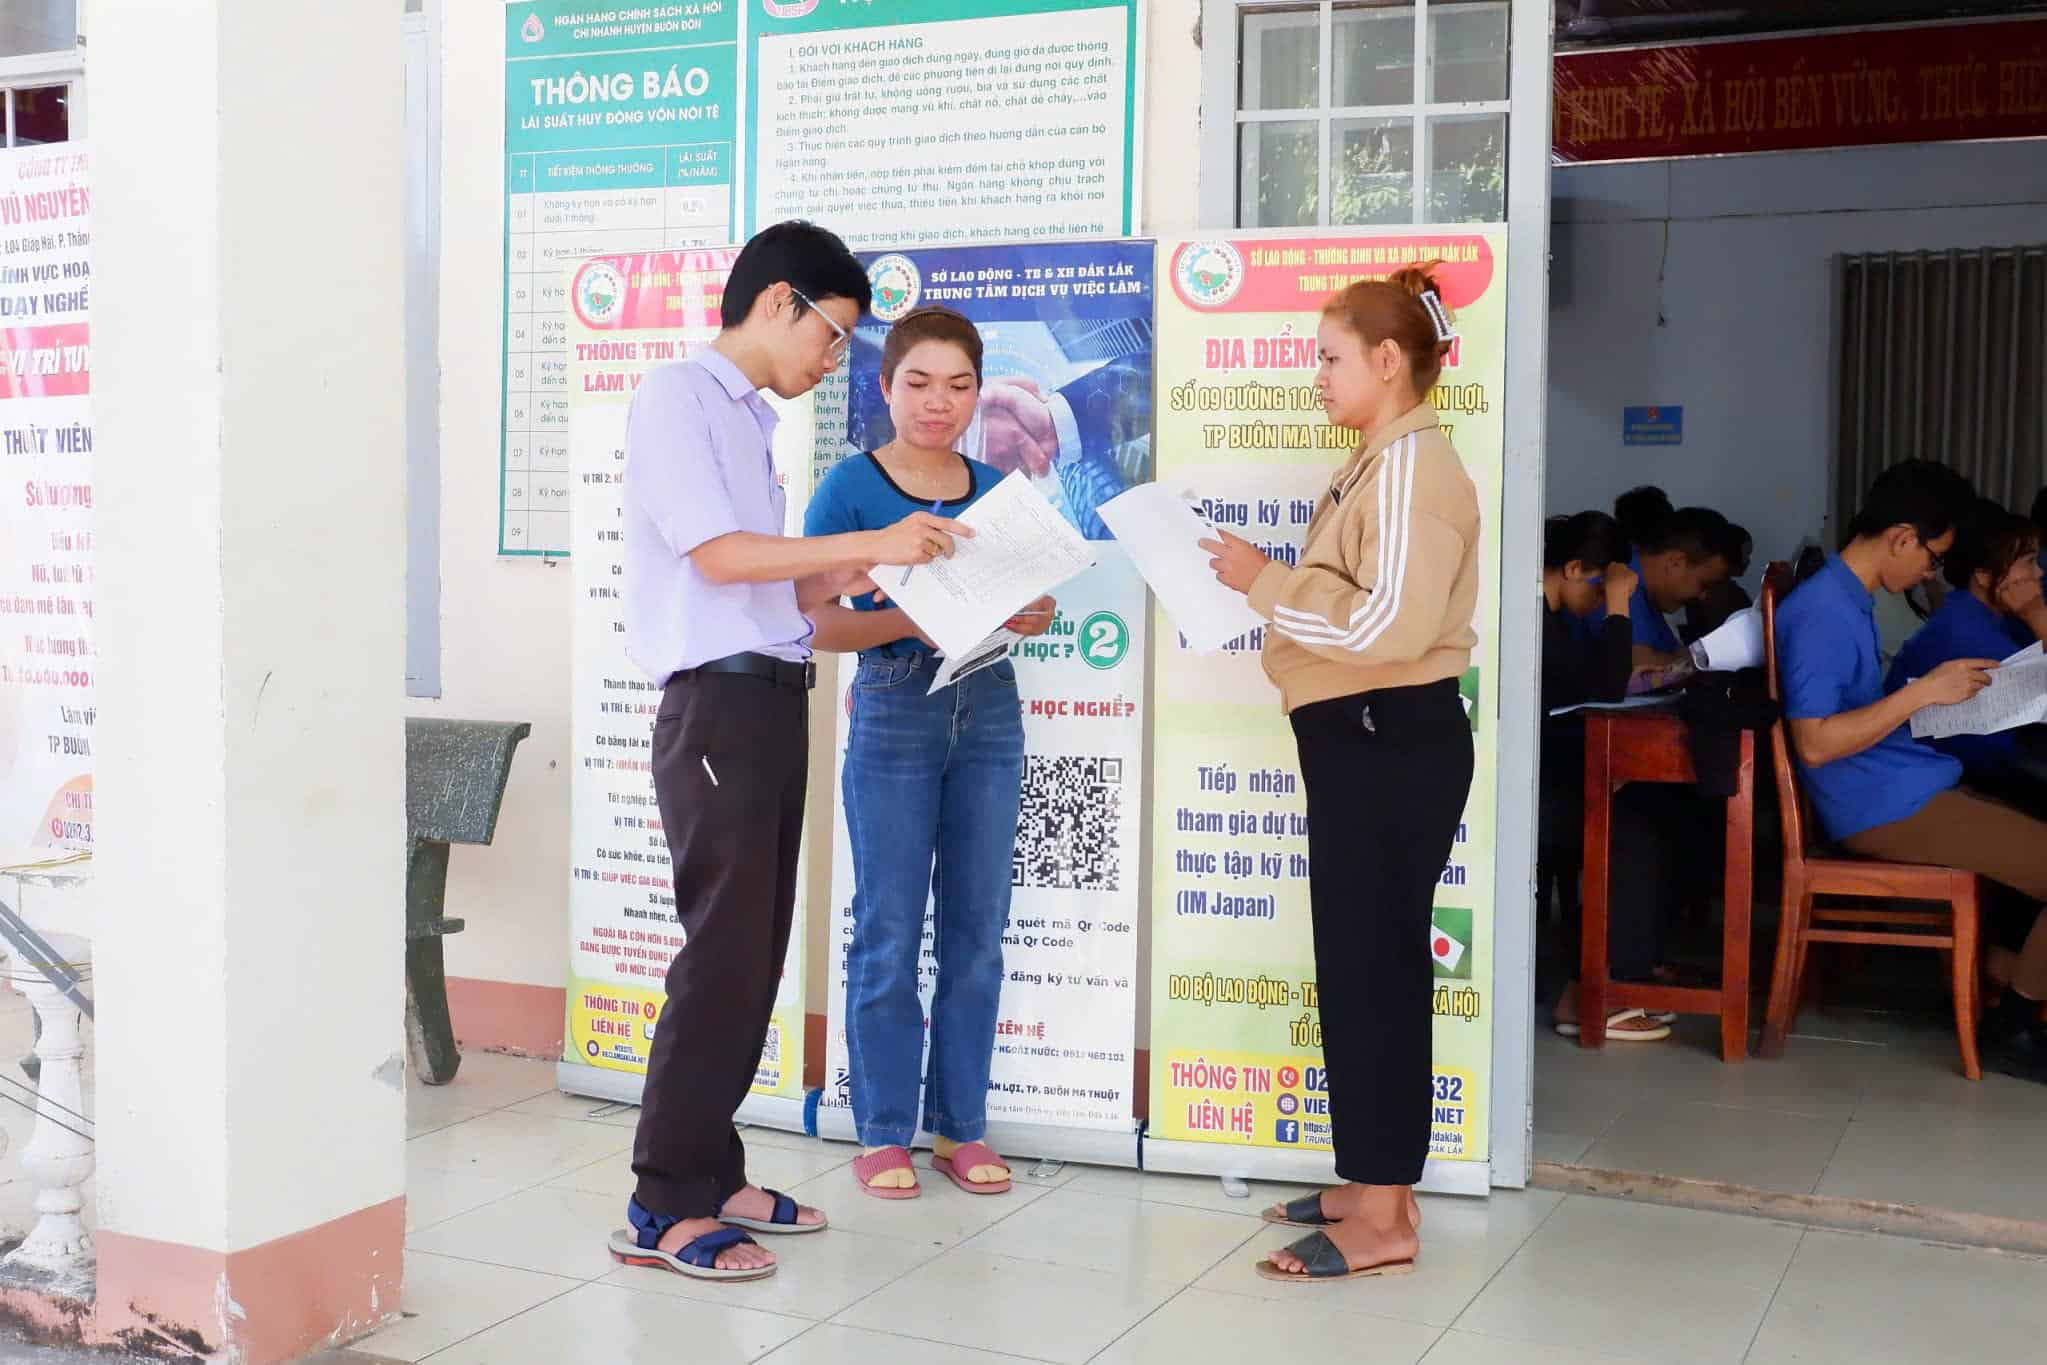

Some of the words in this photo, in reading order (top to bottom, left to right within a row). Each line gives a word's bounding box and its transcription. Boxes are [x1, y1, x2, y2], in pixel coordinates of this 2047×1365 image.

[531, 71, 634, 106] THÔNG
[643, 64, 709, 99] BÁO
[578, 112, 601, 126] HUY
[31, 265, 59, 284] VỰC
[931, 268, 947, 283] SỞ
[950, 269, 975, 283] LAO
[977, 267, 1013, 284] ĐỘNG
[1024, 267, 1042, 280] TB
[1055, 266, 1075, 279] XH
[924, 286, 974, 301] TRUNG
[976, 283, 1009, 299] TÂM
[1011, 285, 1046, 301] DỊCH
[1049, 284, 1069, 300] VỤ
[1071, 280, 1106, 298] VIỆC
[1109, 279, 1142, 295] LÀM
[576, 340, 637, 361] THÔNG
[642, 341, 674, 360] TIN
[1205, 336, 1246, 375] ĐỊA
[1253, 323, 1318, 369] ĐIỂM
[1171, 378, 1195, 412] SỐ
[1198, 386, 1219, 411] 09
[1223, 380, 1286, 411] ĐƯỜNG
[1454, 382, 1488, 415] LỢI,
[56, 421, 92, 453] VIÊN
[1203, 425, 1225, 448] TP
[1229, 419, 1277, 448] BUÔN
[1281, 425, 1312, 448] MA
[1257, 498, 1280, 527] ký
[1023, 643, 1060, 662] HỌC
[1088, 620, 1120, 659] 2
[1030, 700, 1068, 719] HỌC
[48, 735, 60, 752] TP
[1198, 763, 1237, 794] Tiếp
[1249, 768, 1296, 798] nhận
[1176, 807, 1223, 833] tham
[1228, 809, 1257, 836] gia
[1262, 811, 1287, 841] dự
[1176, 849, 1217, 879] thực
[1223, 851, 1253, 880] tập
[1260, 852, 1283, 879] kỹ
[1176, 890, 1208, 916] (IM
[1210, 892, 1276, 920] Japan)
[1077, 920, 1092, 932] Qr
[1000, 934, 1020, 945] mã
[1023, 935, 1039, 948] Qr
[1041, 936, 1074, 948] Code
[584, 993, 618, 1013] THÔNG
[621, 998, 639, 1016] TIN
[1169, 975, 1190, 1000] DO
[1193, 972, 1213, 1008] BỘ
[1216, 978, 1244, 1004] LAO
[1247, 977, 1290, 1010] ĐỘNG
[1452, 986, 1480, 1023] HỘI
[1290, 1013, 1310, 1047] TỔ
[1171, 1057, 1237, 1091] THÔNG
[1242, 1067, 1271, 1093] TIN
[1026, 1085, 1041, 1095] TP.
[1188, 1098, 1225, 1133] LIÊN
[1231, 1102, 1254, 1140] HỆ
